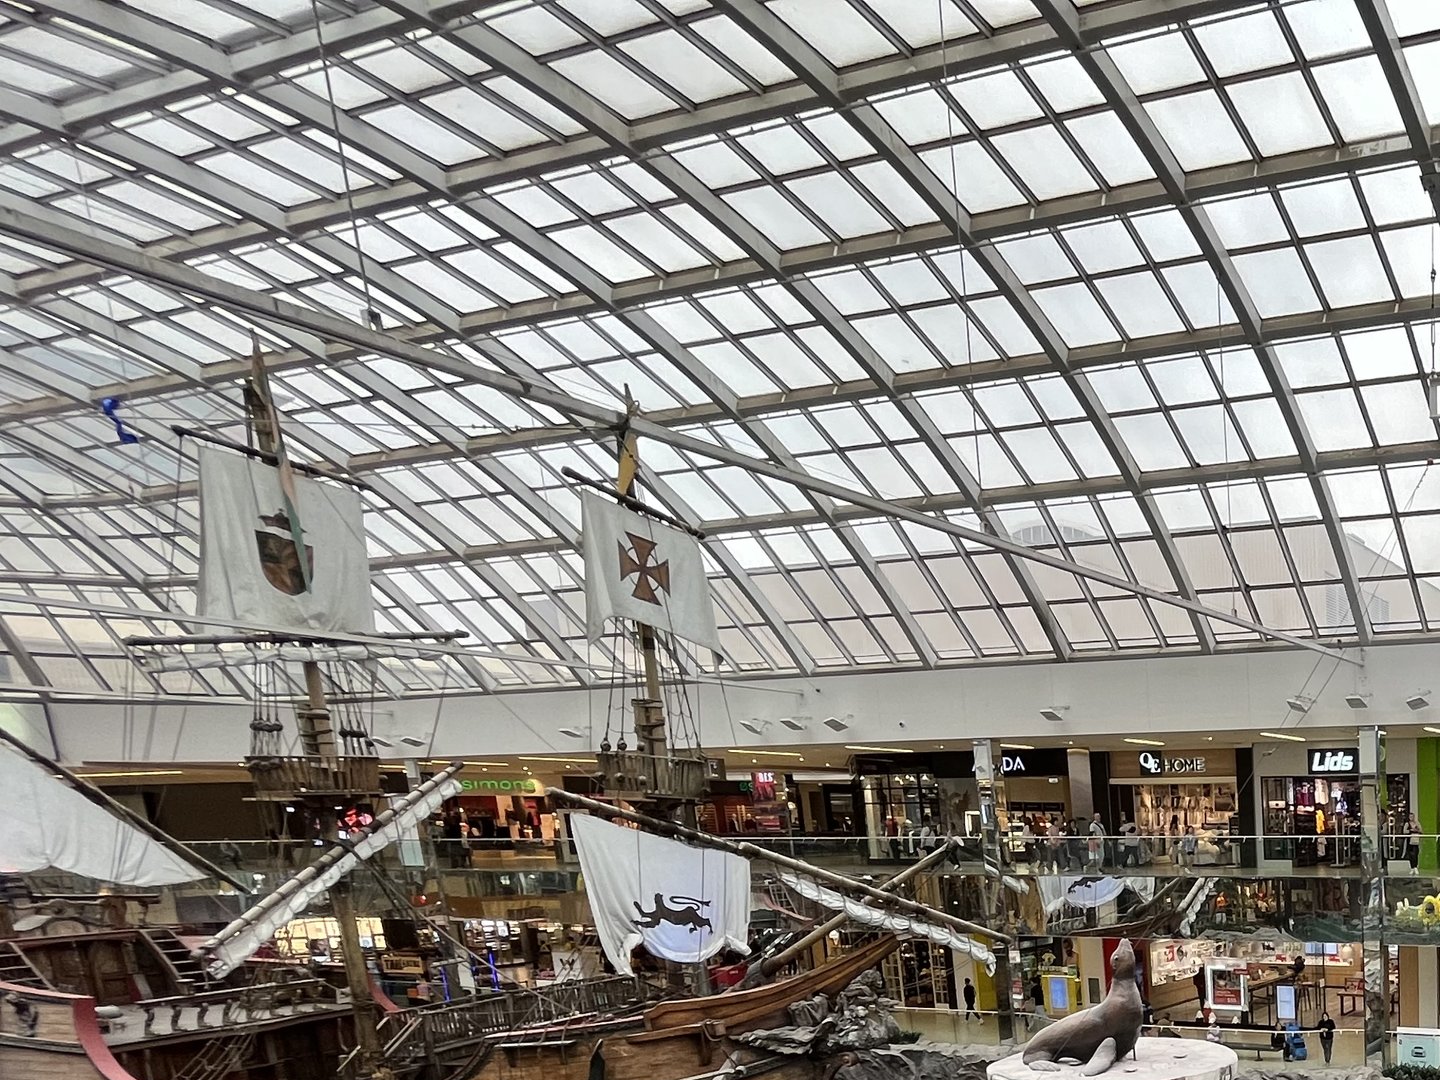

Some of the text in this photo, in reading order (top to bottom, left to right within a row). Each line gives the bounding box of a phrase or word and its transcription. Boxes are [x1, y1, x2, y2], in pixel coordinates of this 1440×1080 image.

[1139, 752, 1206, 773] QE HOME
[1312, 751, 1354, 772] Lids
[461, 779, 535, 791] simons
